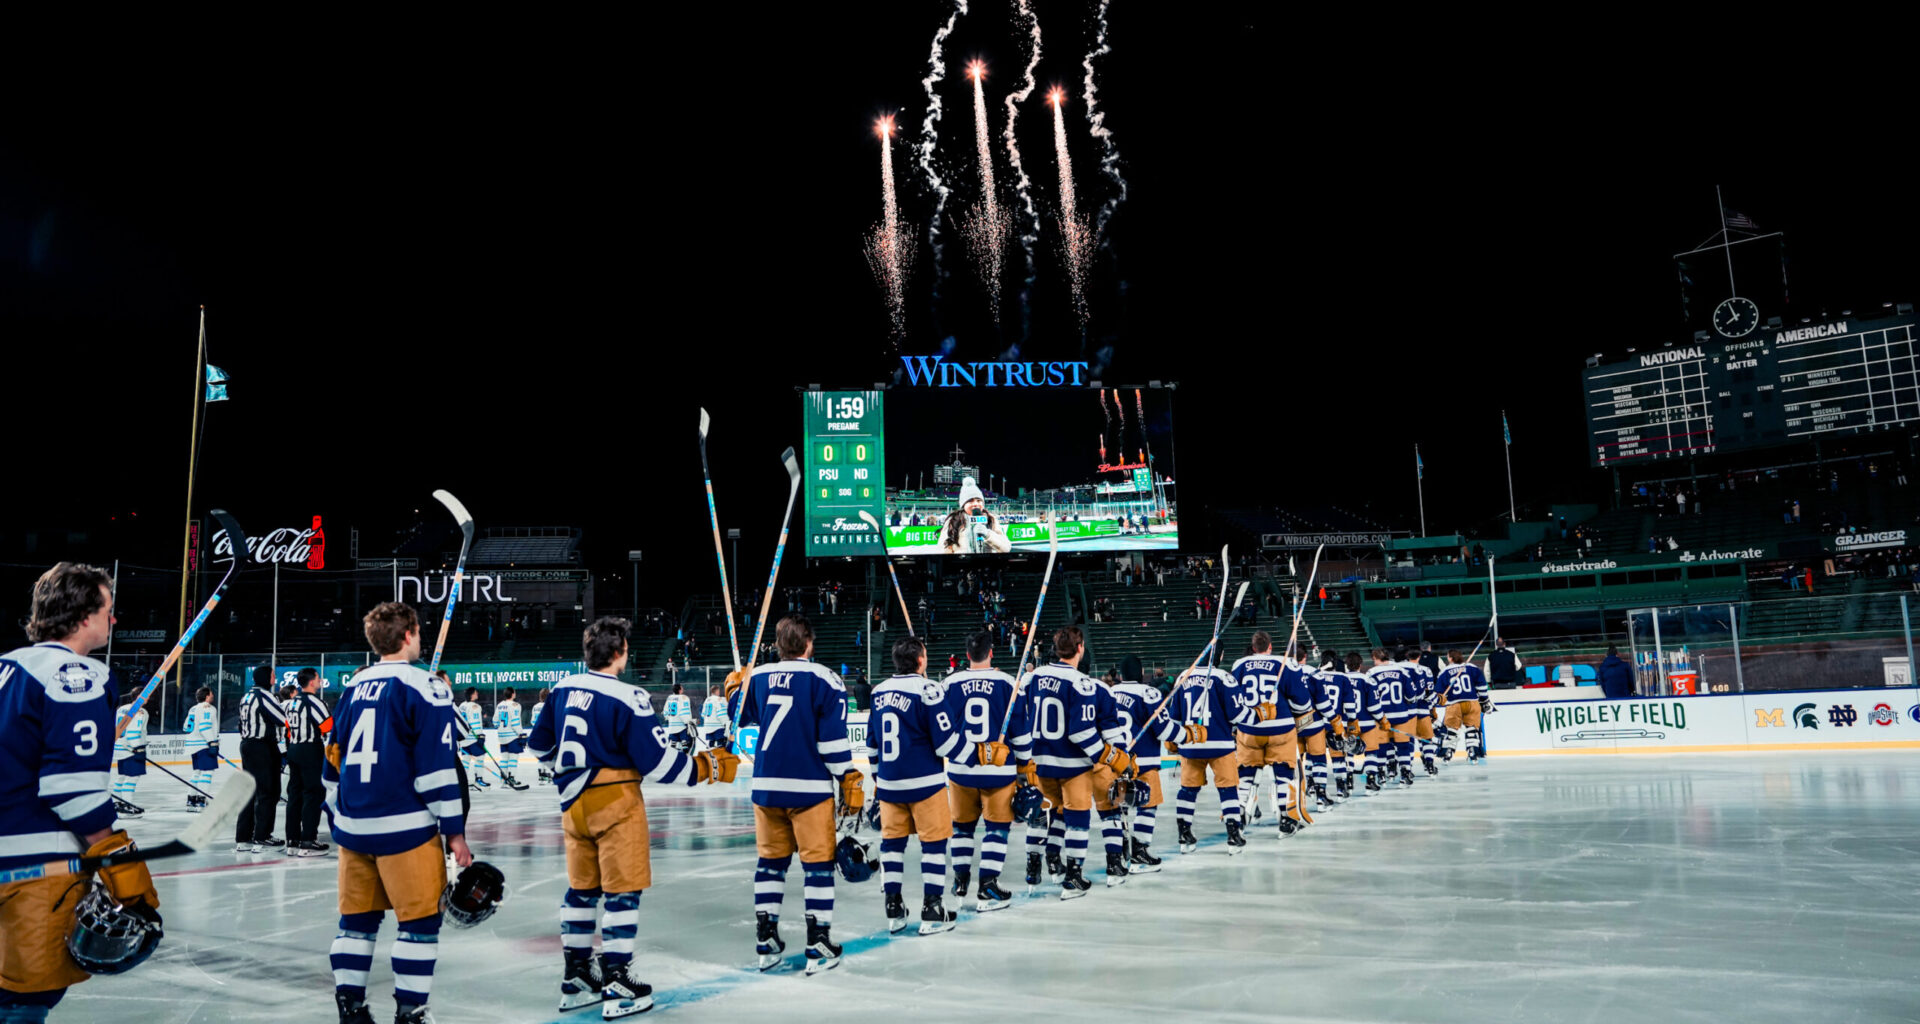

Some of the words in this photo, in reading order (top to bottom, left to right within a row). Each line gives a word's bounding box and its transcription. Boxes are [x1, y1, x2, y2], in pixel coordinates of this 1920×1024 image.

[1776, 322, 1847, 344] AMERICAN
[1725, 340, 1764, 352] OFFICIALS
[1640, 346, 1705, 367] NATIONAL
[1726, 358, 1758, 371] BATTER
[900, 356, 1088, 387] WINTRUST
[1807, 370, 1836, 379] MINNESOTA
[1718, 390, 1732, 398] BALL
[827, 397, 864, 419] 1:59
[828, 422, 859, 431] PREGAME
[824, 445, 833, 462] 0
[856, 444, 866, 461] 0
[819, 468, 838, 480] PSU
[854, 468, 868, 480] ND
[822, 488, 828, 498] 0
[838, 488, 852, 496] SOG
[864, 488, 869, 497] 0
[832, 517, 869, 531] Frozen
[814, 534, 878, 544] CONFINES
[906, 532, 920, 542] BIG
[1835, 530, 1906, 546] GRAINGER
[1699, 548, 1763, 561] Advocate
[1552, 559, 1616, 572] tastytrade
[114, 630, 166, 638] GRAINGER
[1245, 660, 1275, 672] SERGEEV
[221, 670, 241, 686] BEAM
[455, 672, 472, 684] BIG
[475, 672, 493, 683] TEN
[496, 671, 534, 682] HOCKEY
[538, 670, 570, 682] SERIES
[768, 672, 794, 690] DYCK
[1452, 674, 1472, 695] 30
[1676, 680, 1685, 690] G
[1892, 674, 1905, 683] N
[961, 680, 994, 696] PETERS
[1242, 674, 1278, 707] 35
[1378, 682, 1402, 705] 20
[565, 690, 594, 711] DOWD
[838, 698, 846, 720] 7
[1184, 692, 1212, 726] 14
[1232, 693, 1244, 708] 14
[936, 712, 952, 732] 8
[964, 697, 990, 743] 9
[1032, 696, 1065, 740] 10
[1081, 704, 1096, 722] 10
[1536, 704, 1621, 734] WRIGLEY
[1630, 702, 1686, 729] FIELD
[1755, 708, 1785, 728] M
[761, 694, 794, 751] 7
[1116, 710, 1133, 751] 3
[73, 720, 98, 756] 3
[345, 708, 378, 783] 4
[441, 722, 452, 751] 4
[554, 714, 588, 774] 6
[652, 725, 670, 749] 6
[732, 728, 757, 754] G
[882, 712, 900, 762] 8
[613, 984, 634, 998] CCM
